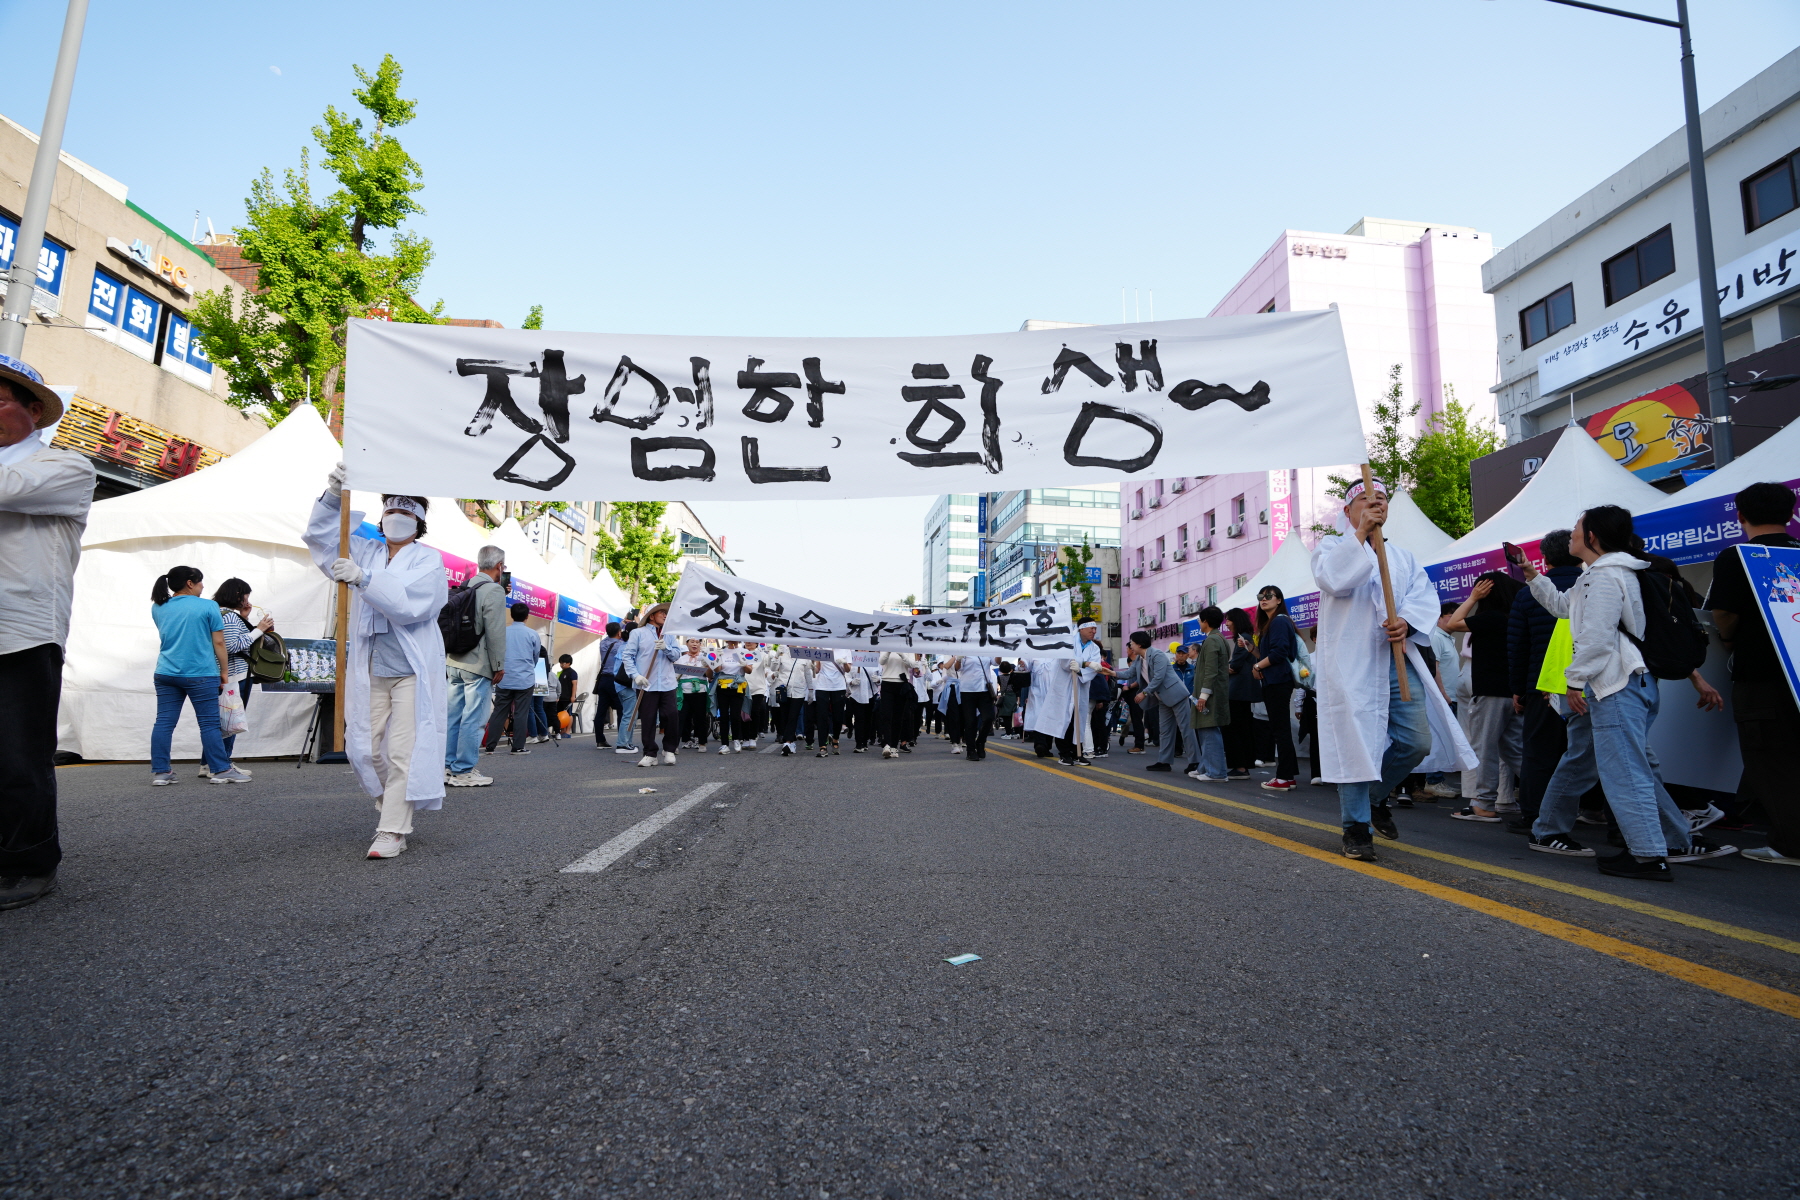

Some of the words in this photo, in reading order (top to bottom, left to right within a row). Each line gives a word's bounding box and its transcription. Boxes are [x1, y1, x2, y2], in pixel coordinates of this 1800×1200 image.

[1623, 299, 1690, 350] 수유
[1718, 248, 1797, 305] 미박
[1563, 337, 1588, 356] 삼겹살
[1592, 322, 1619, 342] 전문점
[456, 349, 846, 491] 장엄한
[1273, 503, 1289, 541] 여성의원
[1440, 577, 1460, 592] 작은
[1025, 600, 1074, 650] 혼
